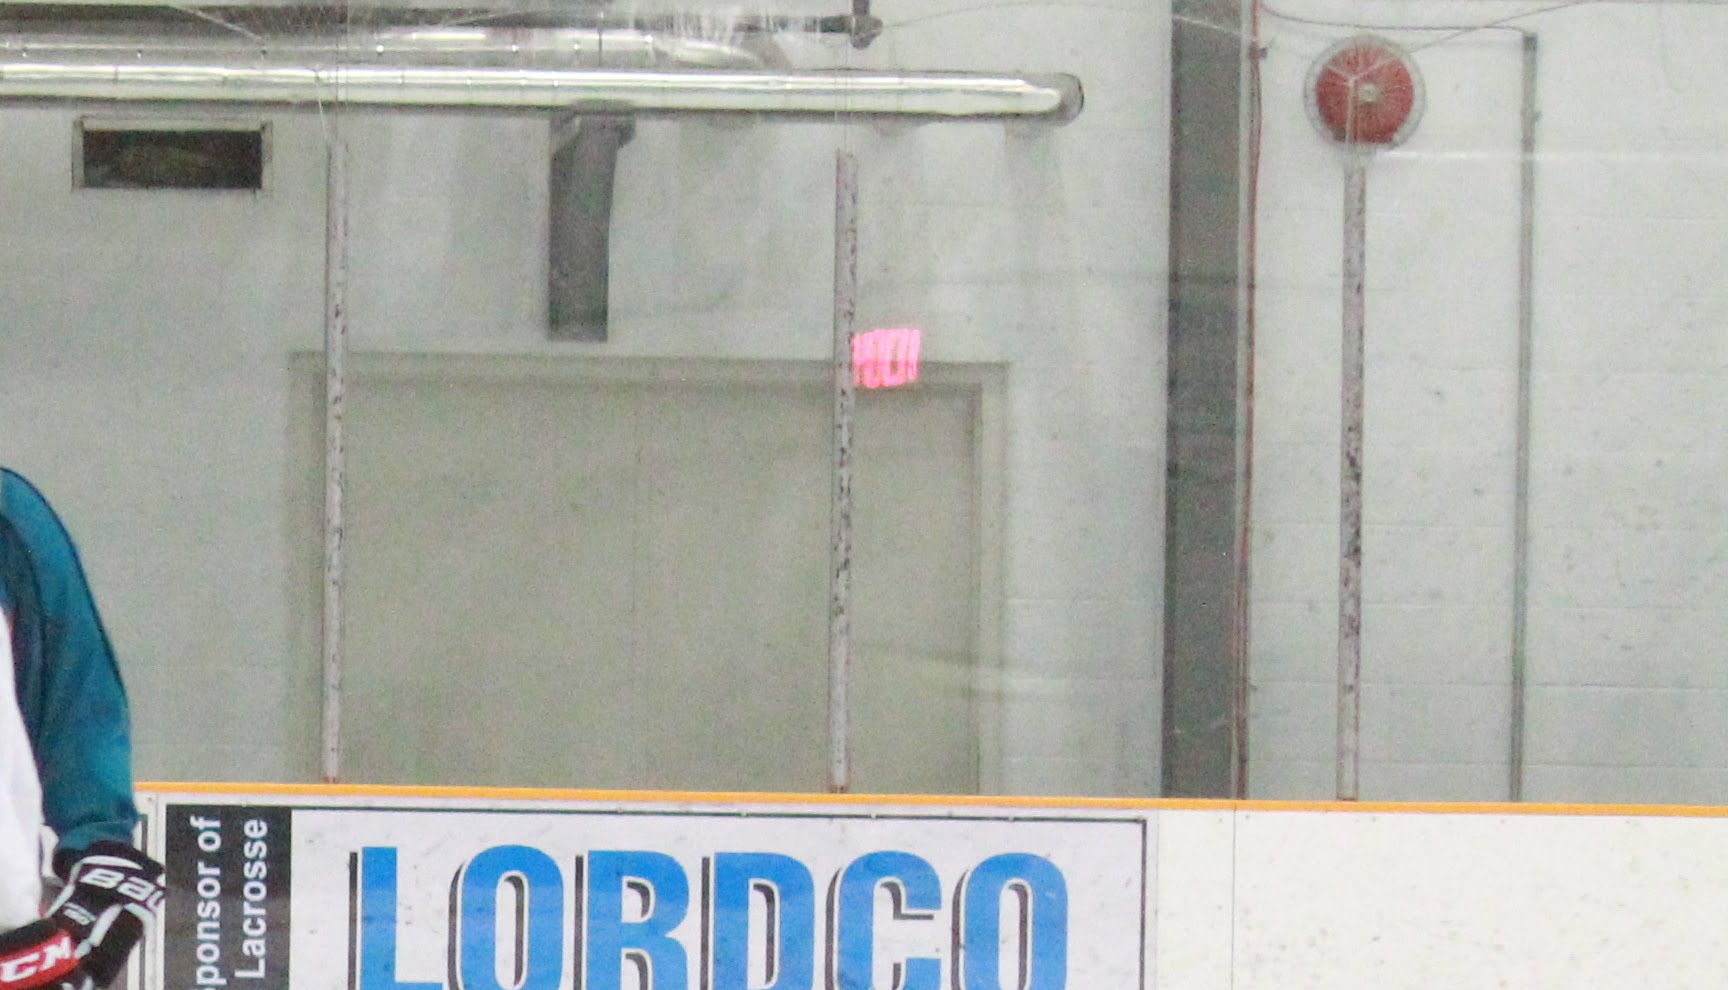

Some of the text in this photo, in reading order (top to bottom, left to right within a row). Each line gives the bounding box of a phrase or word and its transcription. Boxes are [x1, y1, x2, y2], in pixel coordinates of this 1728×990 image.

[190, 815, 222, 852] of
[79, 867, 165, 913] BAU
[234, 818, 268, 980] Lacrosse
